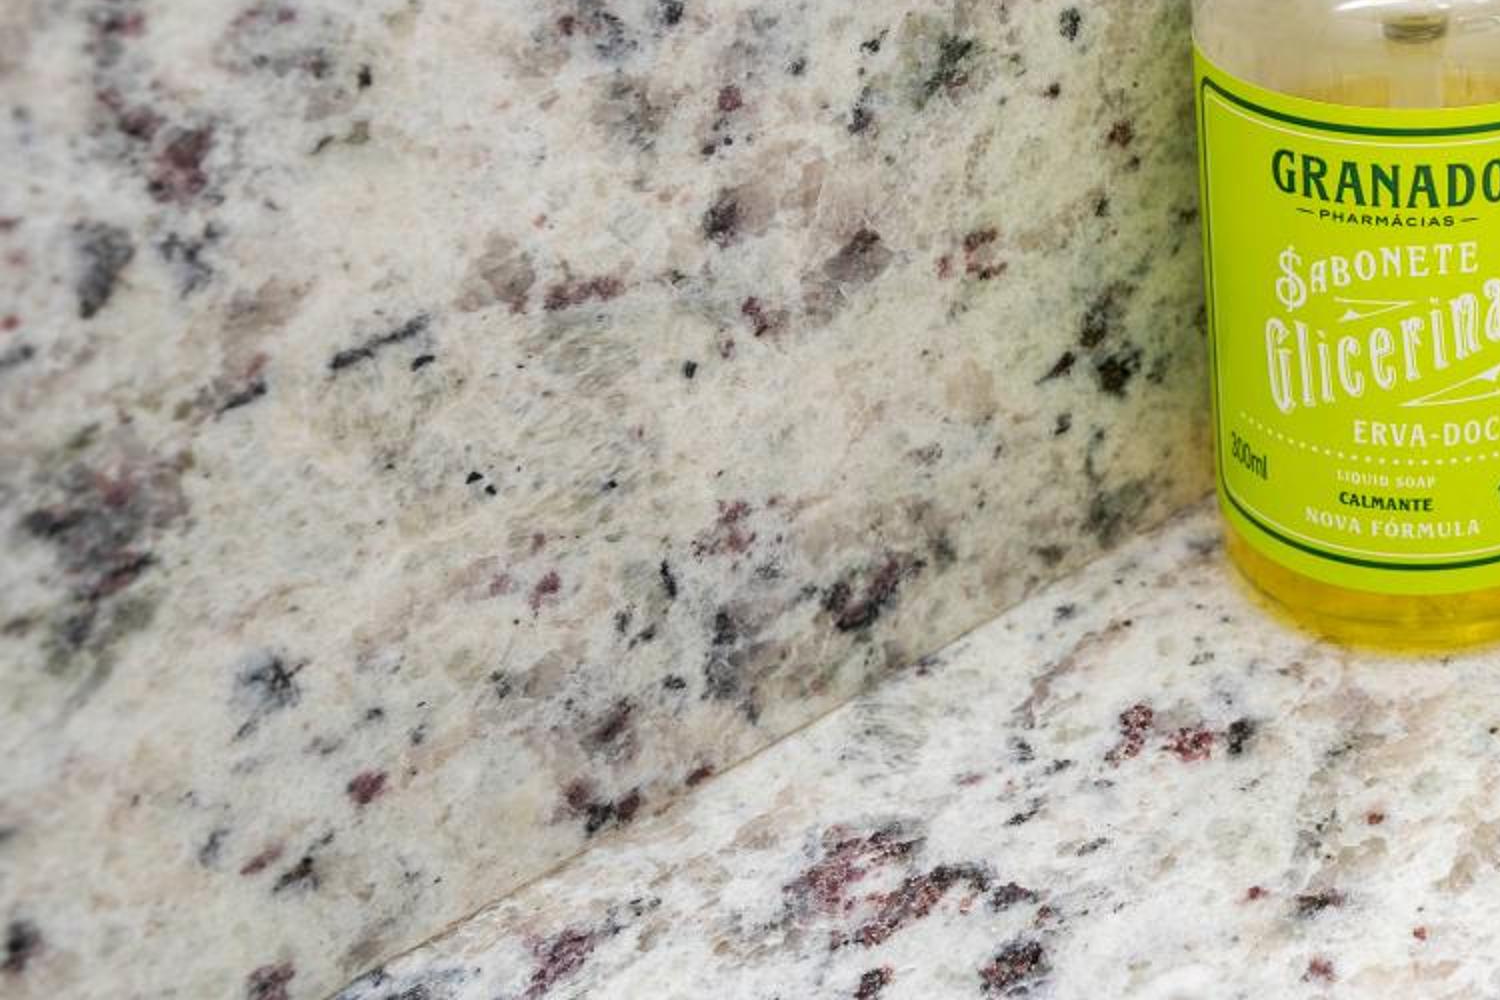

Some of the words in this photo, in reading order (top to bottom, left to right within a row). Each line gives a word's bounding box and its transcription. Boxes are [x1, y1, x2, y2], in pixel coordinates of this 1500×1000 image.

[1319, 209, 1455, 227] PHARMÁCIAS
[1275, 241, 1479, 312] SABONETE
[1339, 491, 1434, 512] CALMANTE
[1304, 506, 1362, 537] NOVA
[1371, 515, 1482, 539] FÓRMULA
